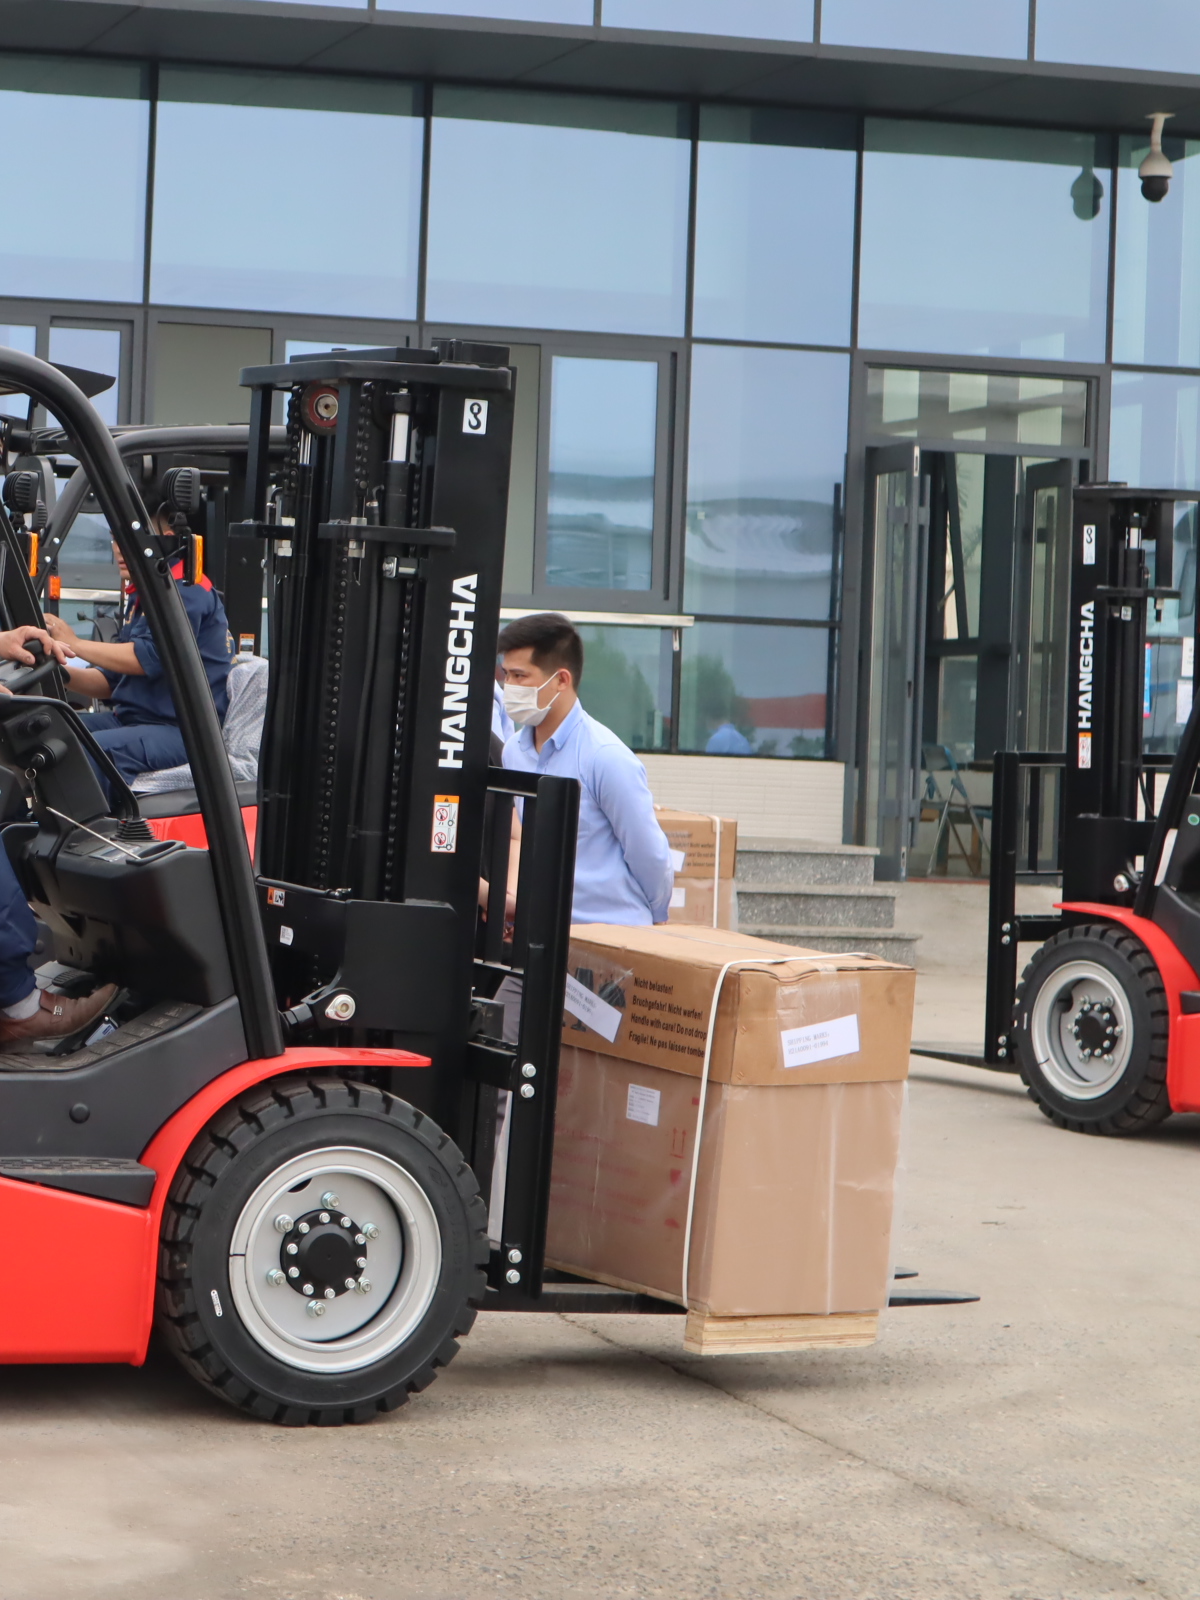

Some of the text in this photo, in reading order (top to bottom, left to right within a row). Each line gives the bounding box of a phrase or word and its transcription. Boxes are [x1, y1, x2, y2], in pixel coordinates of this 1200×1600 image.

[438, 574, 478, 769] HANGCHA
[1078, 600, 1095, 729] HANGCHA
[634, 977, 673, 994] Nicht belasten!
[632, 995, 703, 1020] Bruchgefahr! Nicht werfen!
[631, 1013, 649, 1025] Handle
[650, 1017, 662, 1028] with
[662, 1021, 676, 1032] care!
[676, 1024, 683, 1033] Do
[684, 1026, 694, 1036] not
[628, 1031, 705, 1058] Fragile! Ne pas laisser tombe
